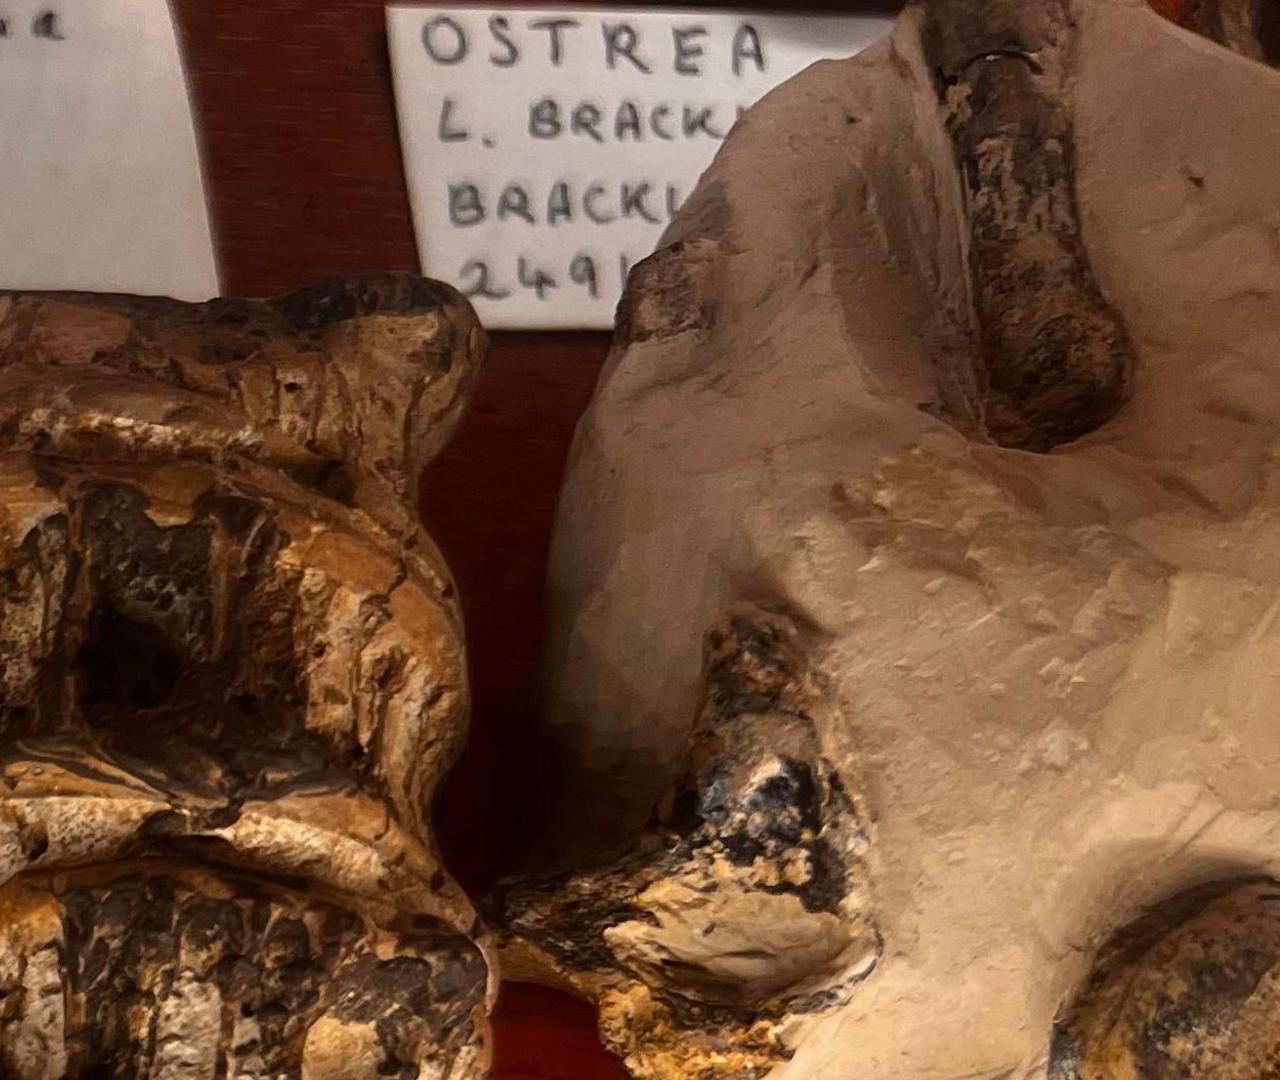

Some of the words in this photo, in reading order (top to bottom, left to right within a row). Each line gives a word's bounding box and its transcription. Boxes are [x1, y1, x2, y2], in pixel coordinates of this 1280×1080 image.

[421, 15, 770, 77] OSTREA
[438, 96, 496, 148] L.
[528, 98, 744, 144] BRACK
